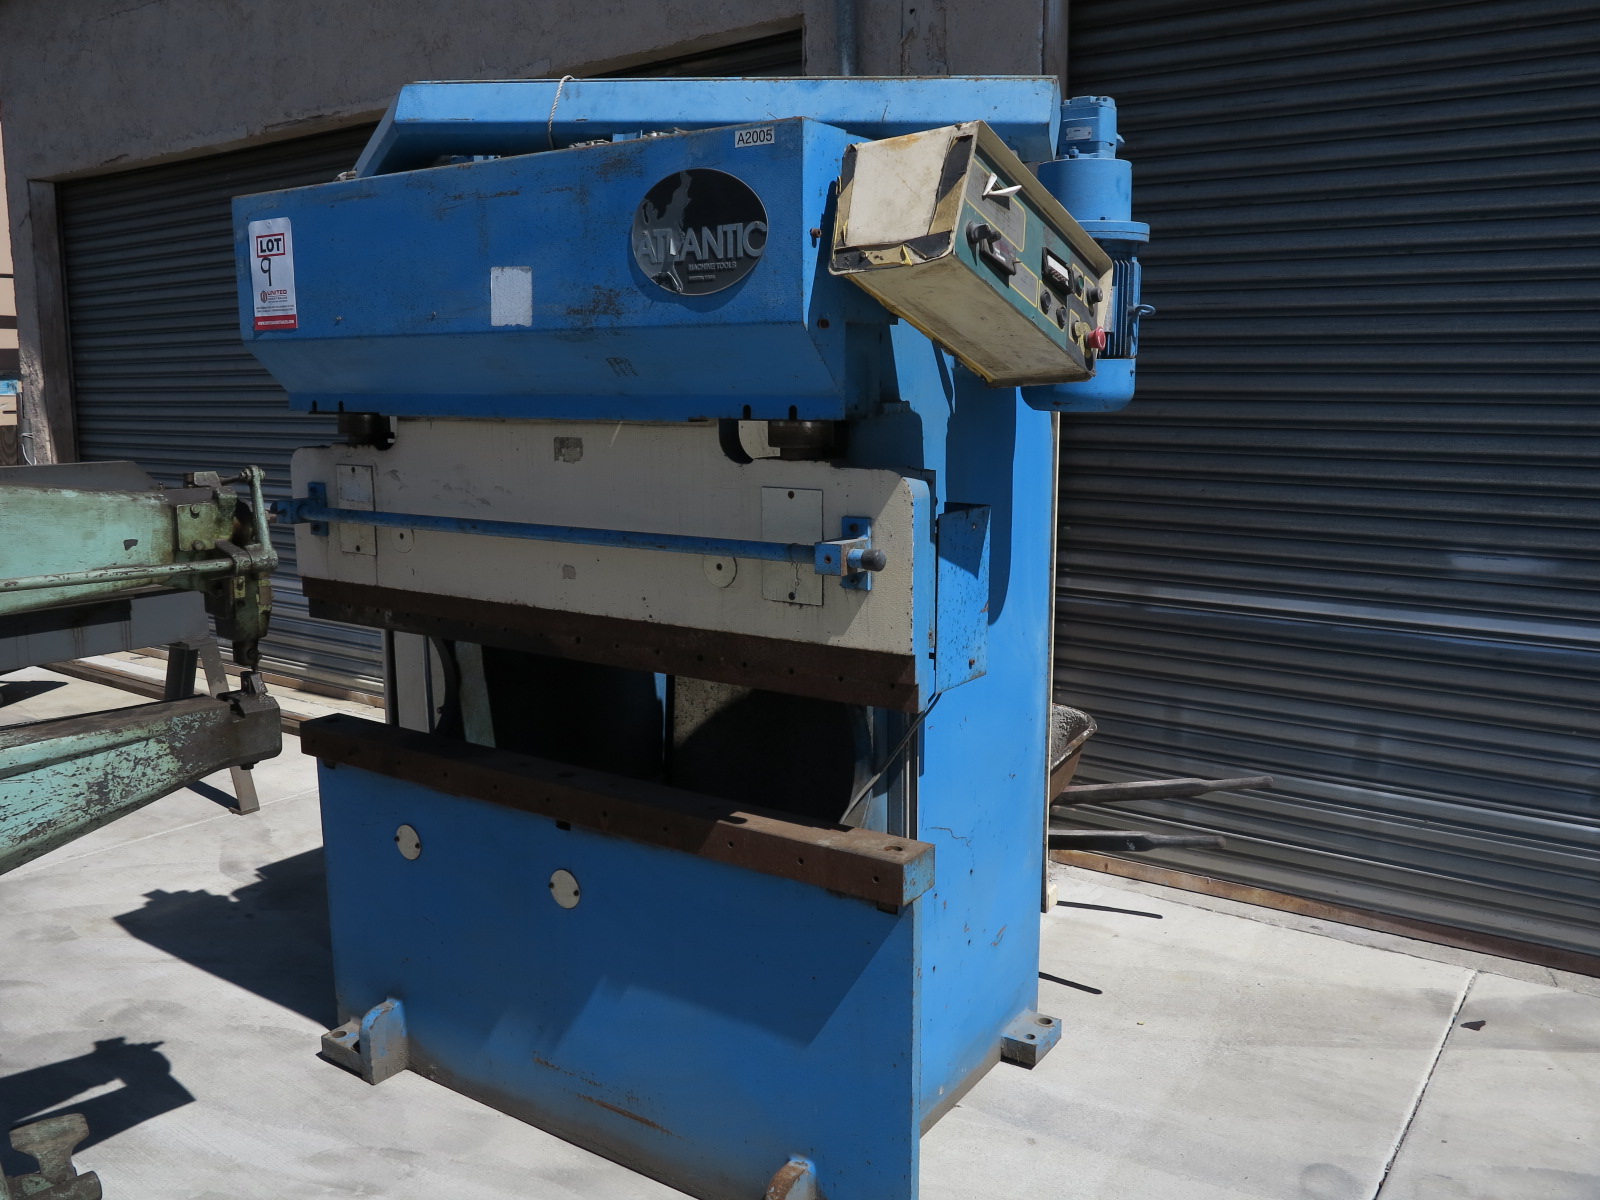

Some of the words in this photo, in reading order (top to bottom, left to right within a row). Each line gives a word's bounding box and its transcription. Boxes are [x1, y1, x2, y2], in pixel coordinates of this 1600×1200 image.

[737, 129, 773, 145] A2005
[260, 238, 282, 253] LOT
[636, 221, 767, 263] ATLANTIC
[260, 257, 272, 287] 9
[688, 262, 716, 271] MACHINE
[716, 261, 737, 270] TOOLS
